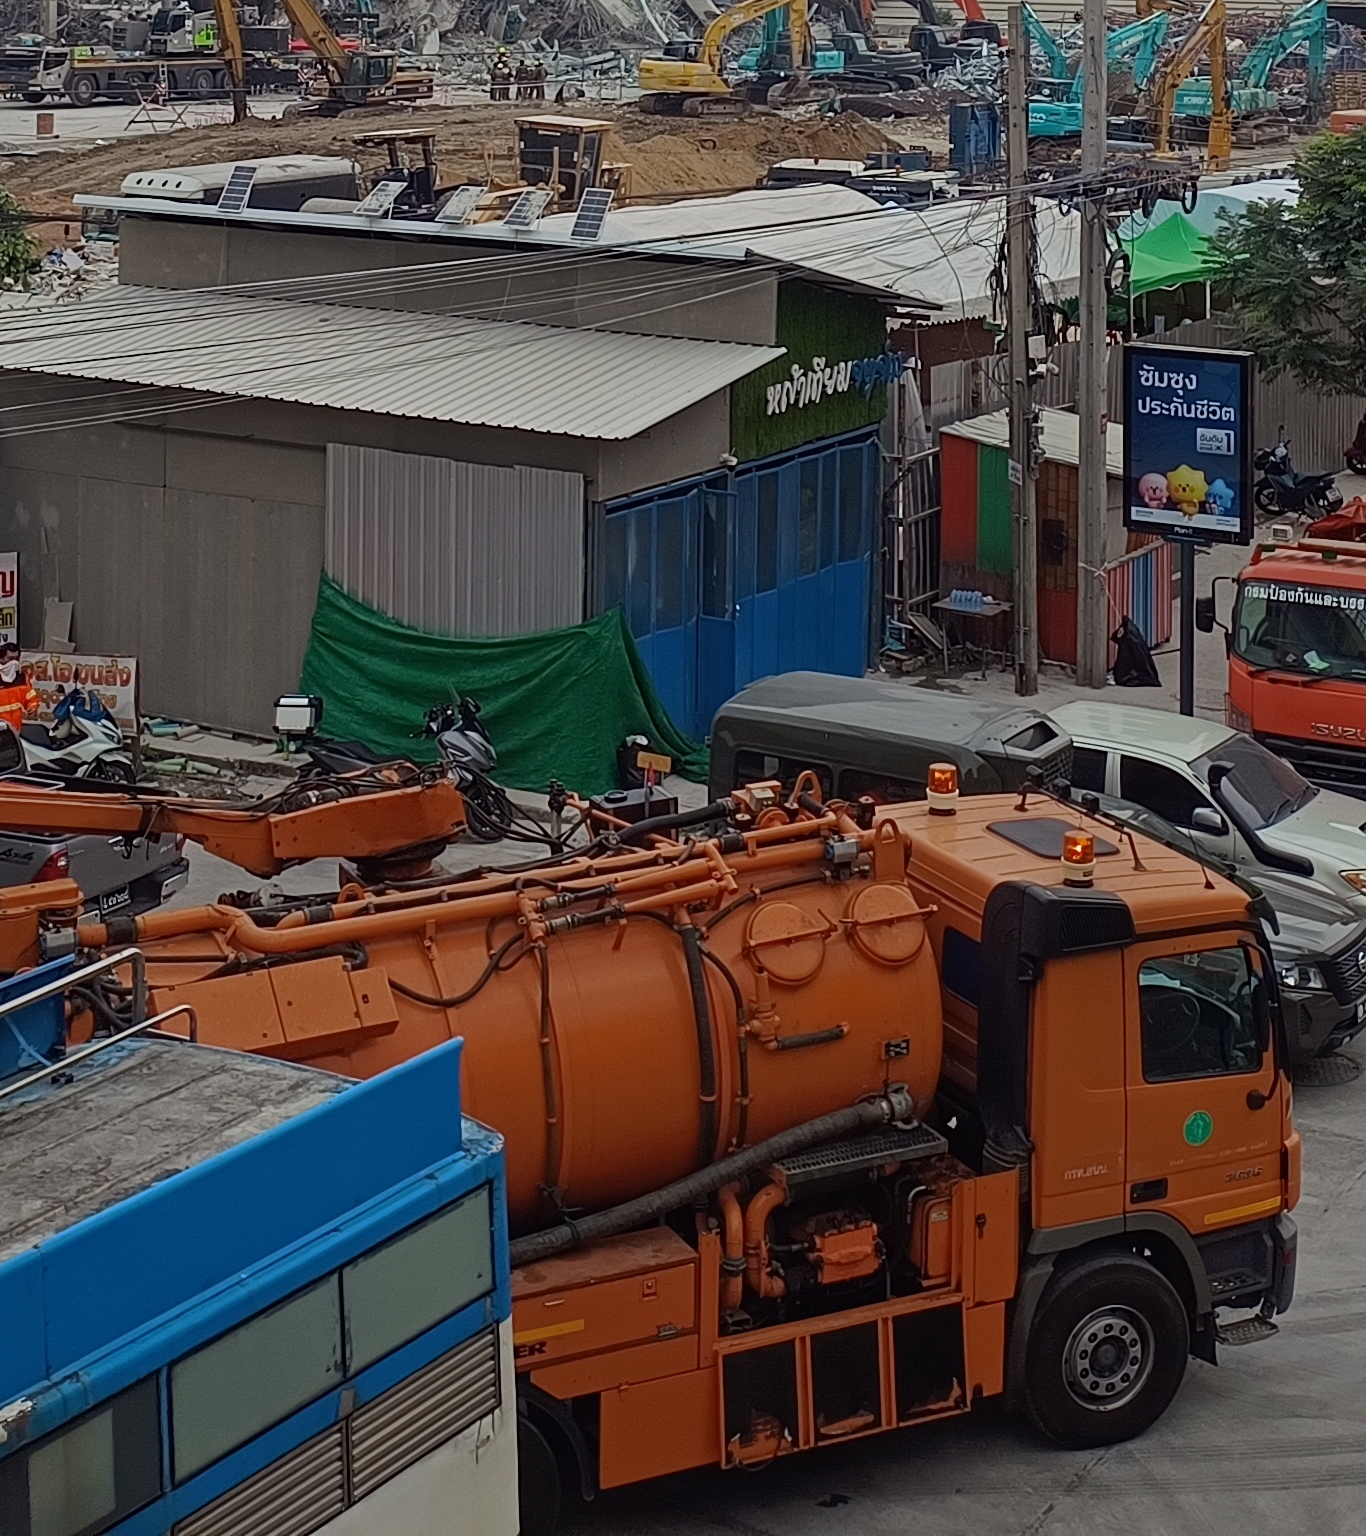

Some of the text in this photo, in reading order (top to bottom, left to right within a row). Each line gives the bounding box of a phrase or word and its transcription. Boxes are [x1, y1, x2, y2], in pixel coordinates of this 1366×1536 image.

[1138, 364, 1197, 396] ซัมซุง
[1137, 396, 1235, 422] ประกันชีวิต
